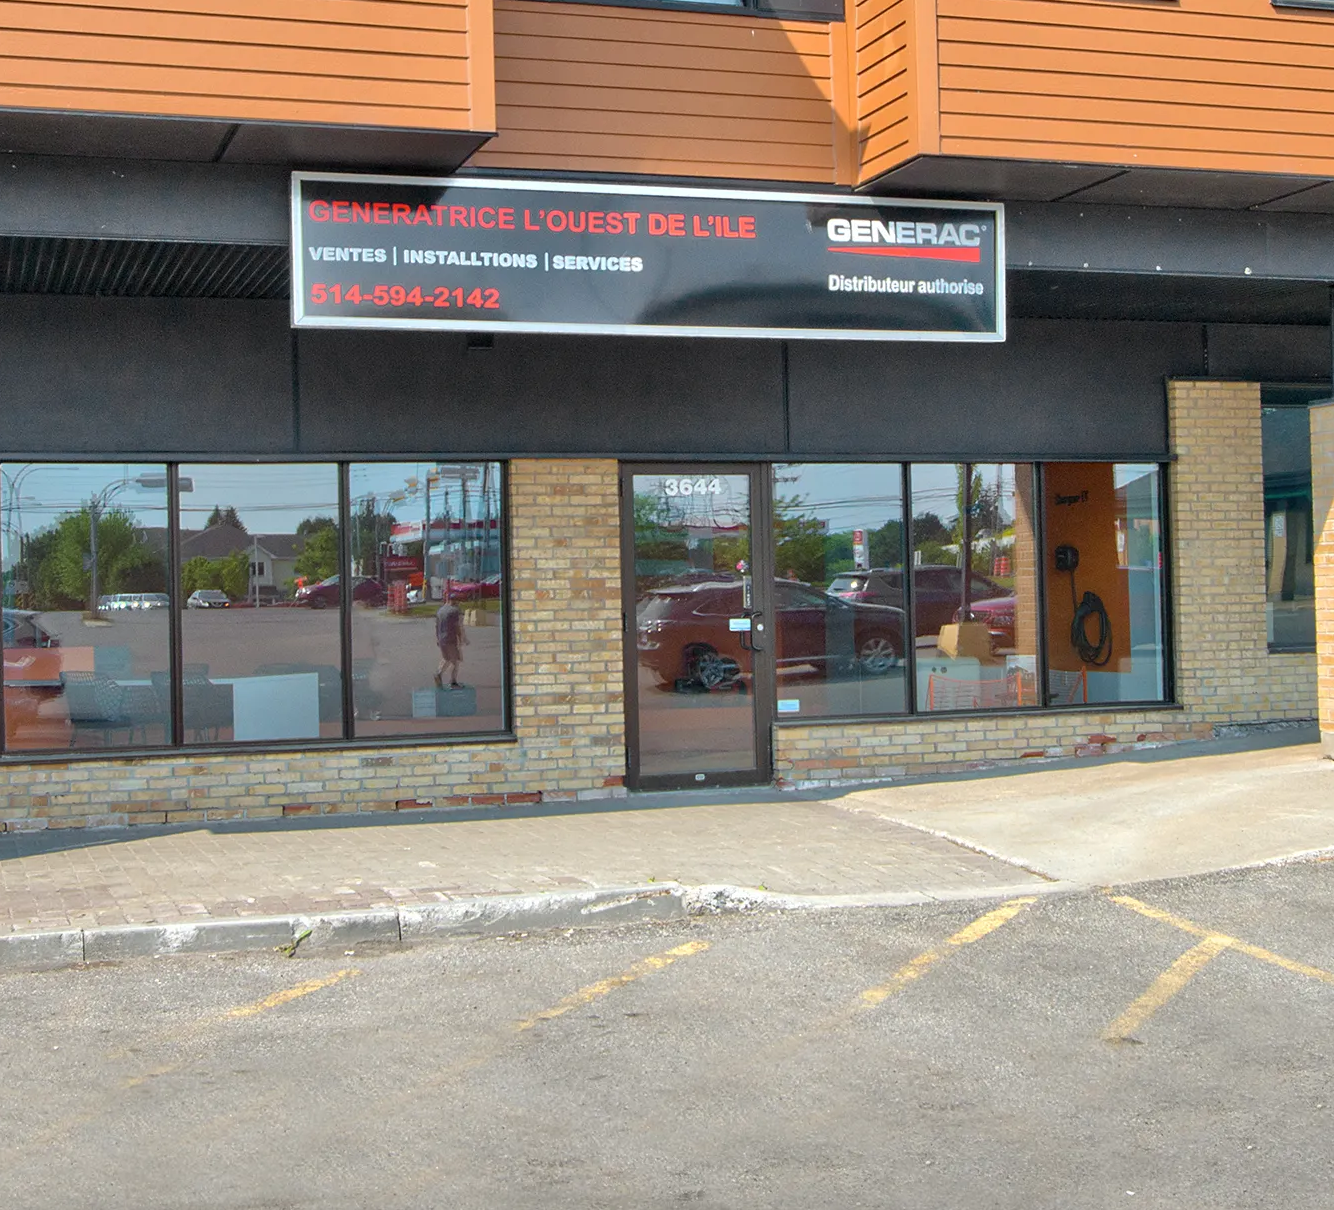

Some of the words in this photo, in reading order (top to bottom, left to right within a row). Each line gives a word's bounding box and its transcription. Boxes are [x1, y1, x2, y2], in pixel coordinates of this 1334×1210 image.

[308, 200, 515, 230] GENERATRICE
[523, 208, 642, 236] L'OUEST
[648, 212, 685, 237] DE
[694, 213, 756, 239] L'ILE
[827, 218, 981, 247] GENERAC
[308, 246, 387, 265] VENTES
[403, 248, 538, 270] INSTALLTIONS
[553, 253, 644, 273] SERVICES
[311, 283, 500, 309] 514-594-2142
[828, 274, 916, 294] Distributeur
[918, 278, 984, 295] authorise
[665, 479, 722, 496] 3644
